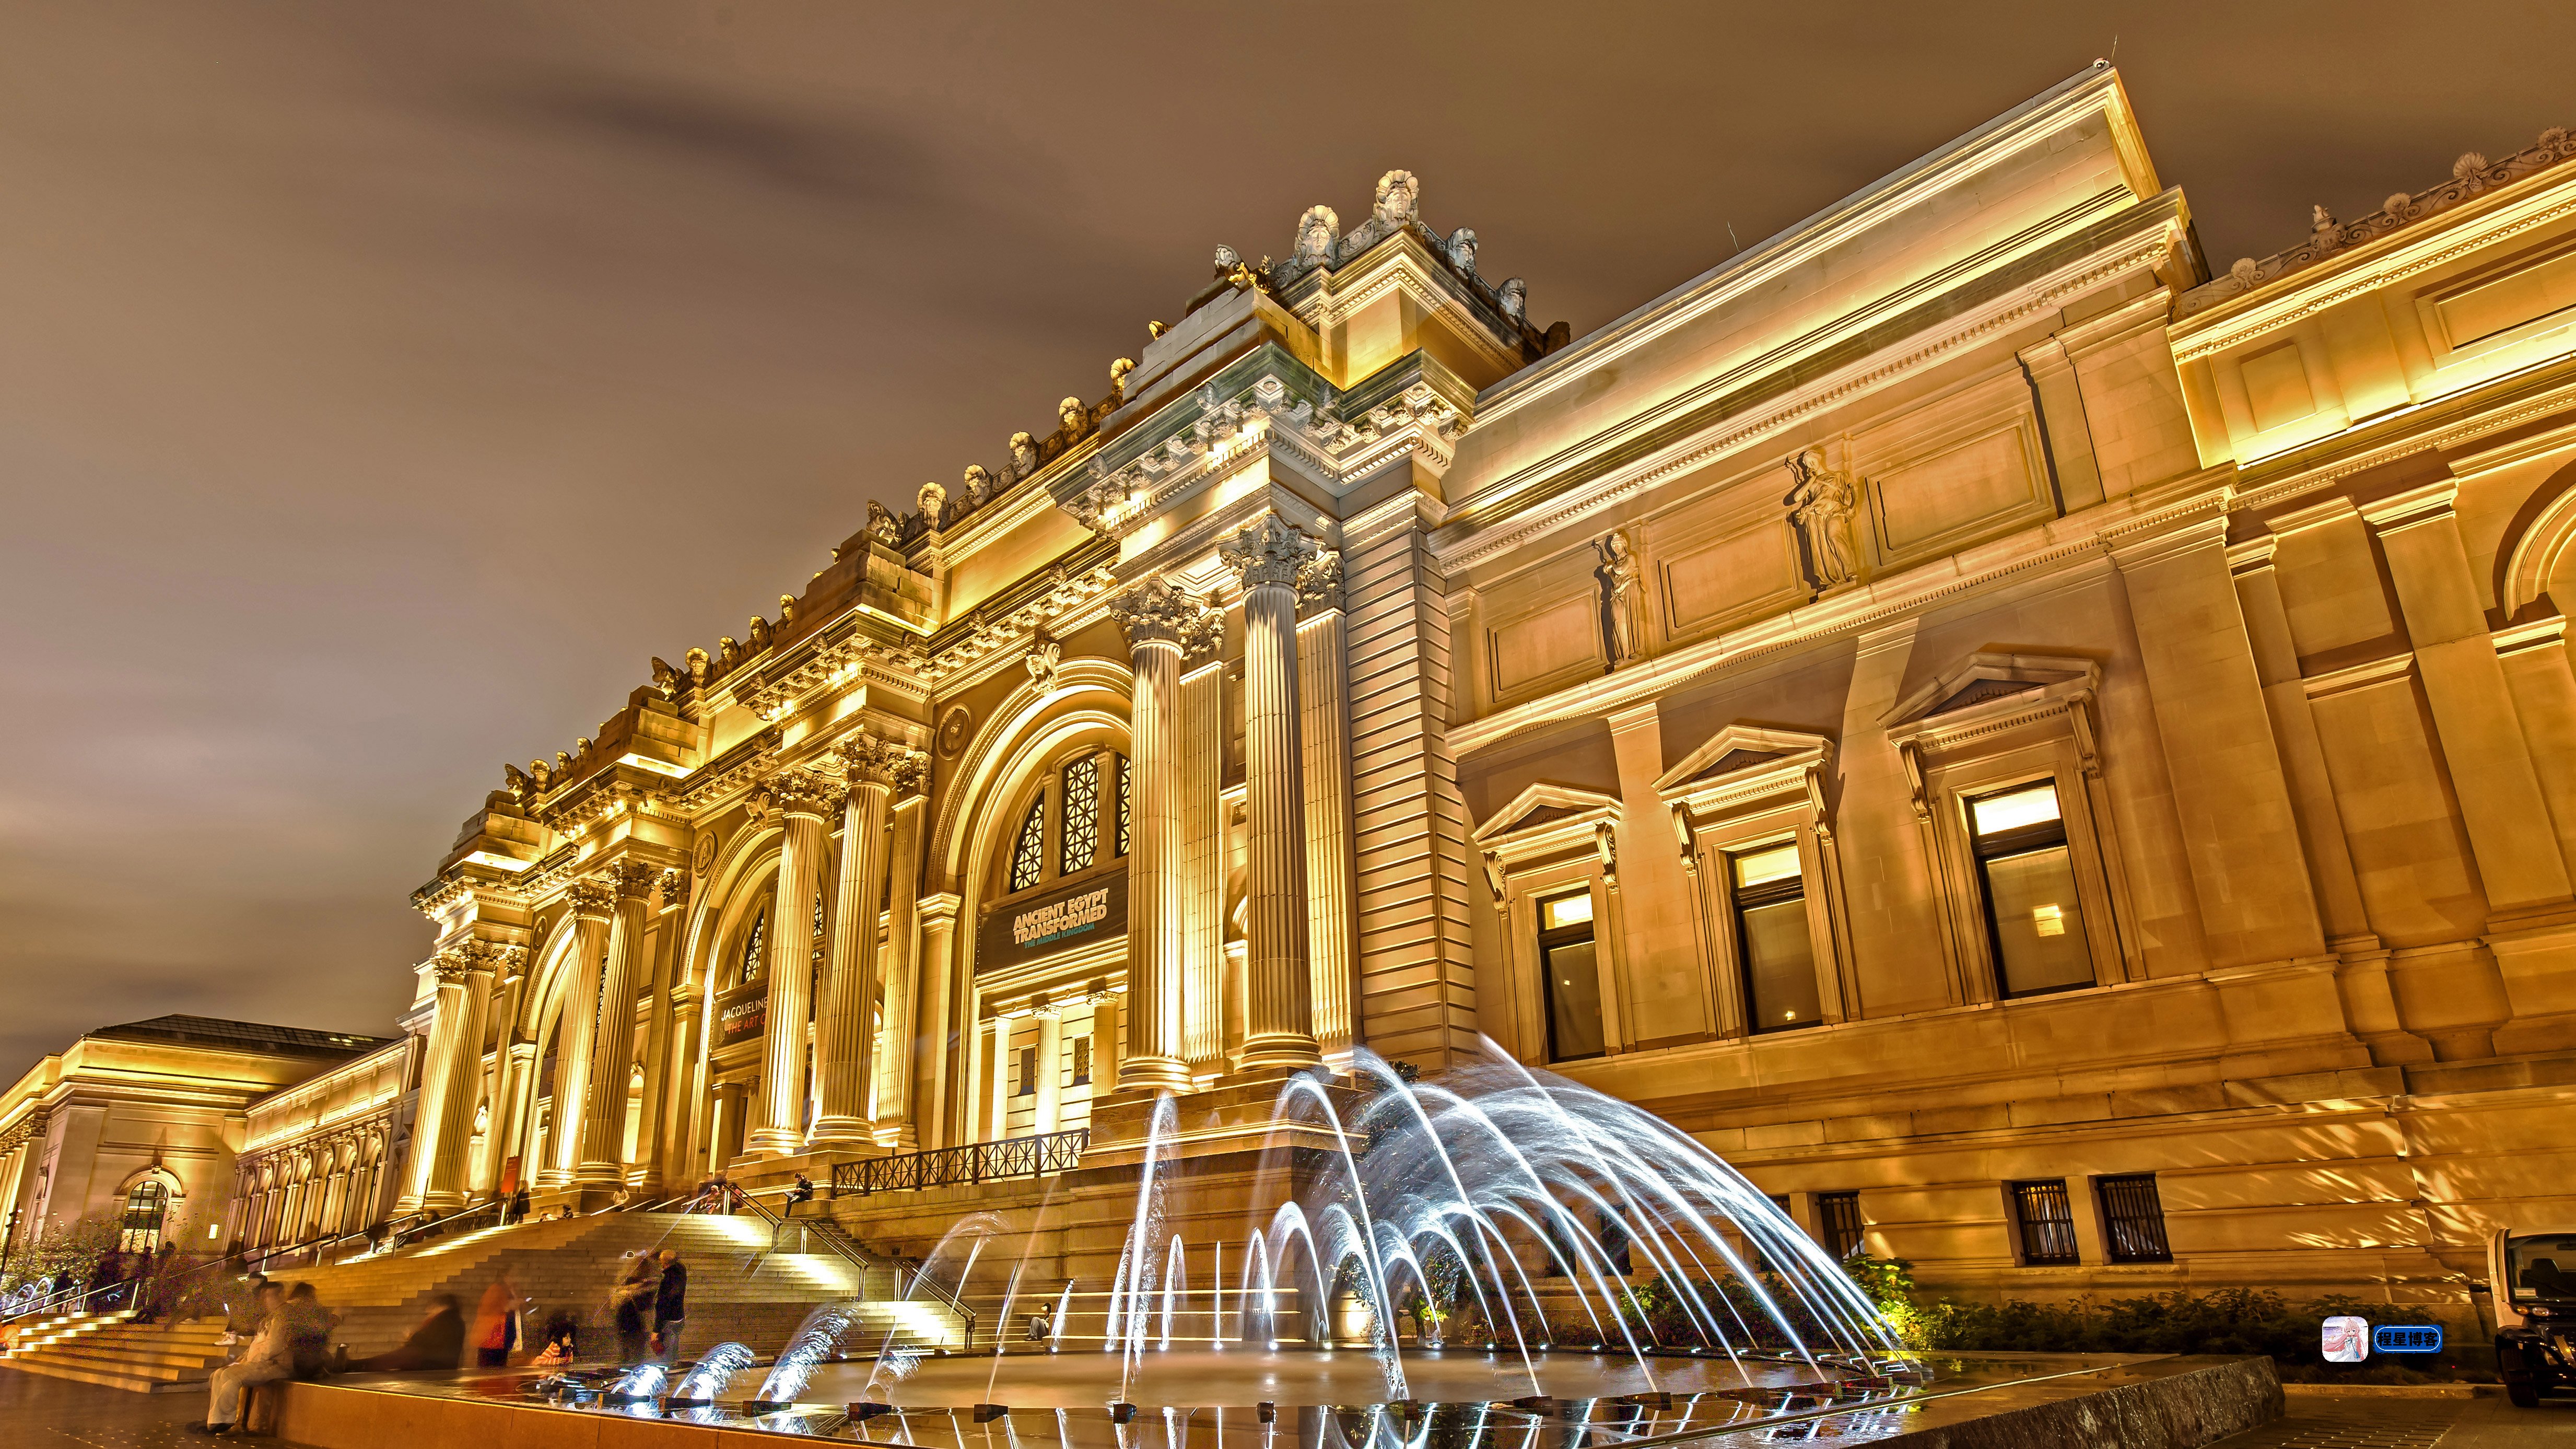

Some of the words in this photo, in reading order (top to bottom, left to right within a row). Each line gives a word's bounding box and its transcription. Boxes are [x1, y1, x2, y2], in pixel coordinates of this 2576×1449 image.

[1013, 902, 1065, 931] ANCIENT
[1068, 887, 1108, 915] EGYPT
[1014, 904, 1107, 944] TRANSFORMED
[1024, 939, 1036, 949] THE
[1036, 932, 1060, 945] MIDDLE
[1061, 922, 1095, 938] KINGDOM
[721, 997, 768, 1021] JACQUELINE
[728, 1020, 742, 1034] THE
[743, 1015, 758, 1030] ART
